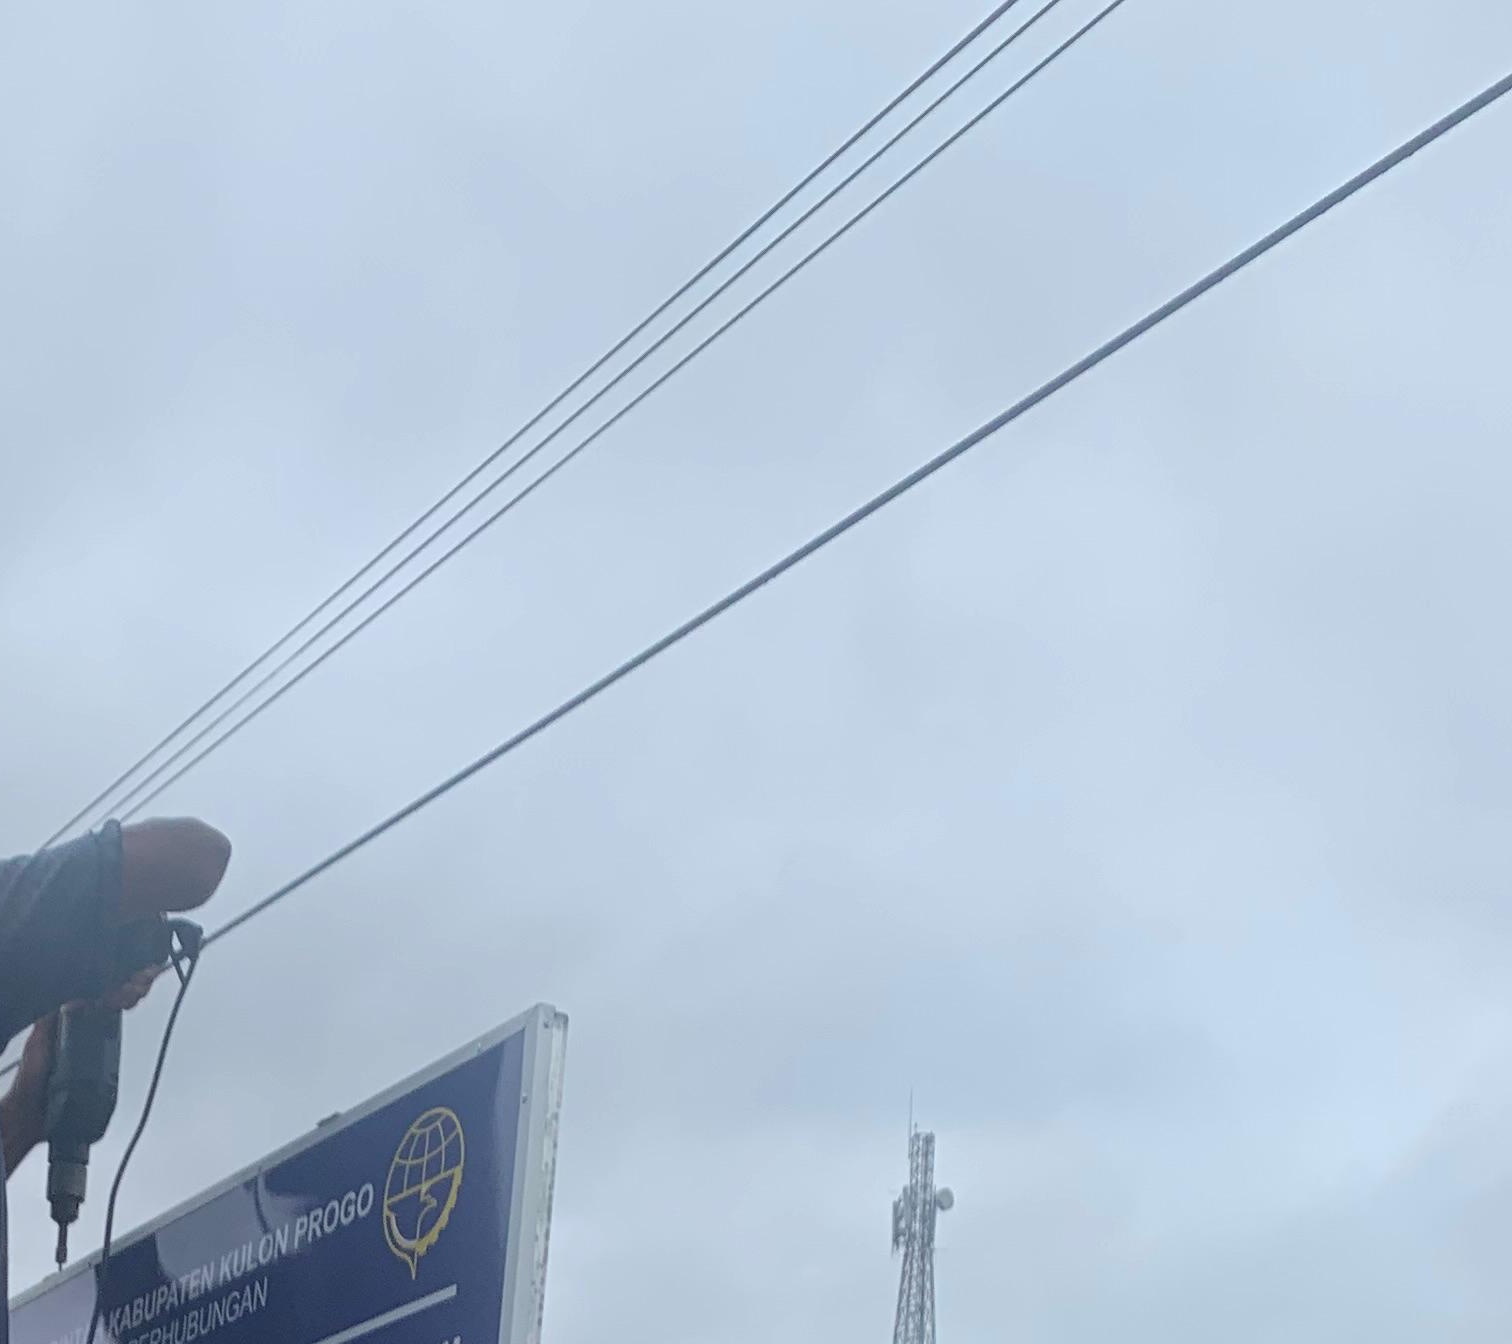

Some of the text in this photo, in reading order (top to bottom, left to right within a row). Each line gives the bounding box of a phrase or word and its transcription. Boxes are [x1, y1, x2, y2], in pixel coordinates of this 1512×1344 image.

[108, 1261, 215, 1336] KABUPATEN
[219, 1224, 289, 1287] KULON
[294, 1182, 375, 1249] PROGO
